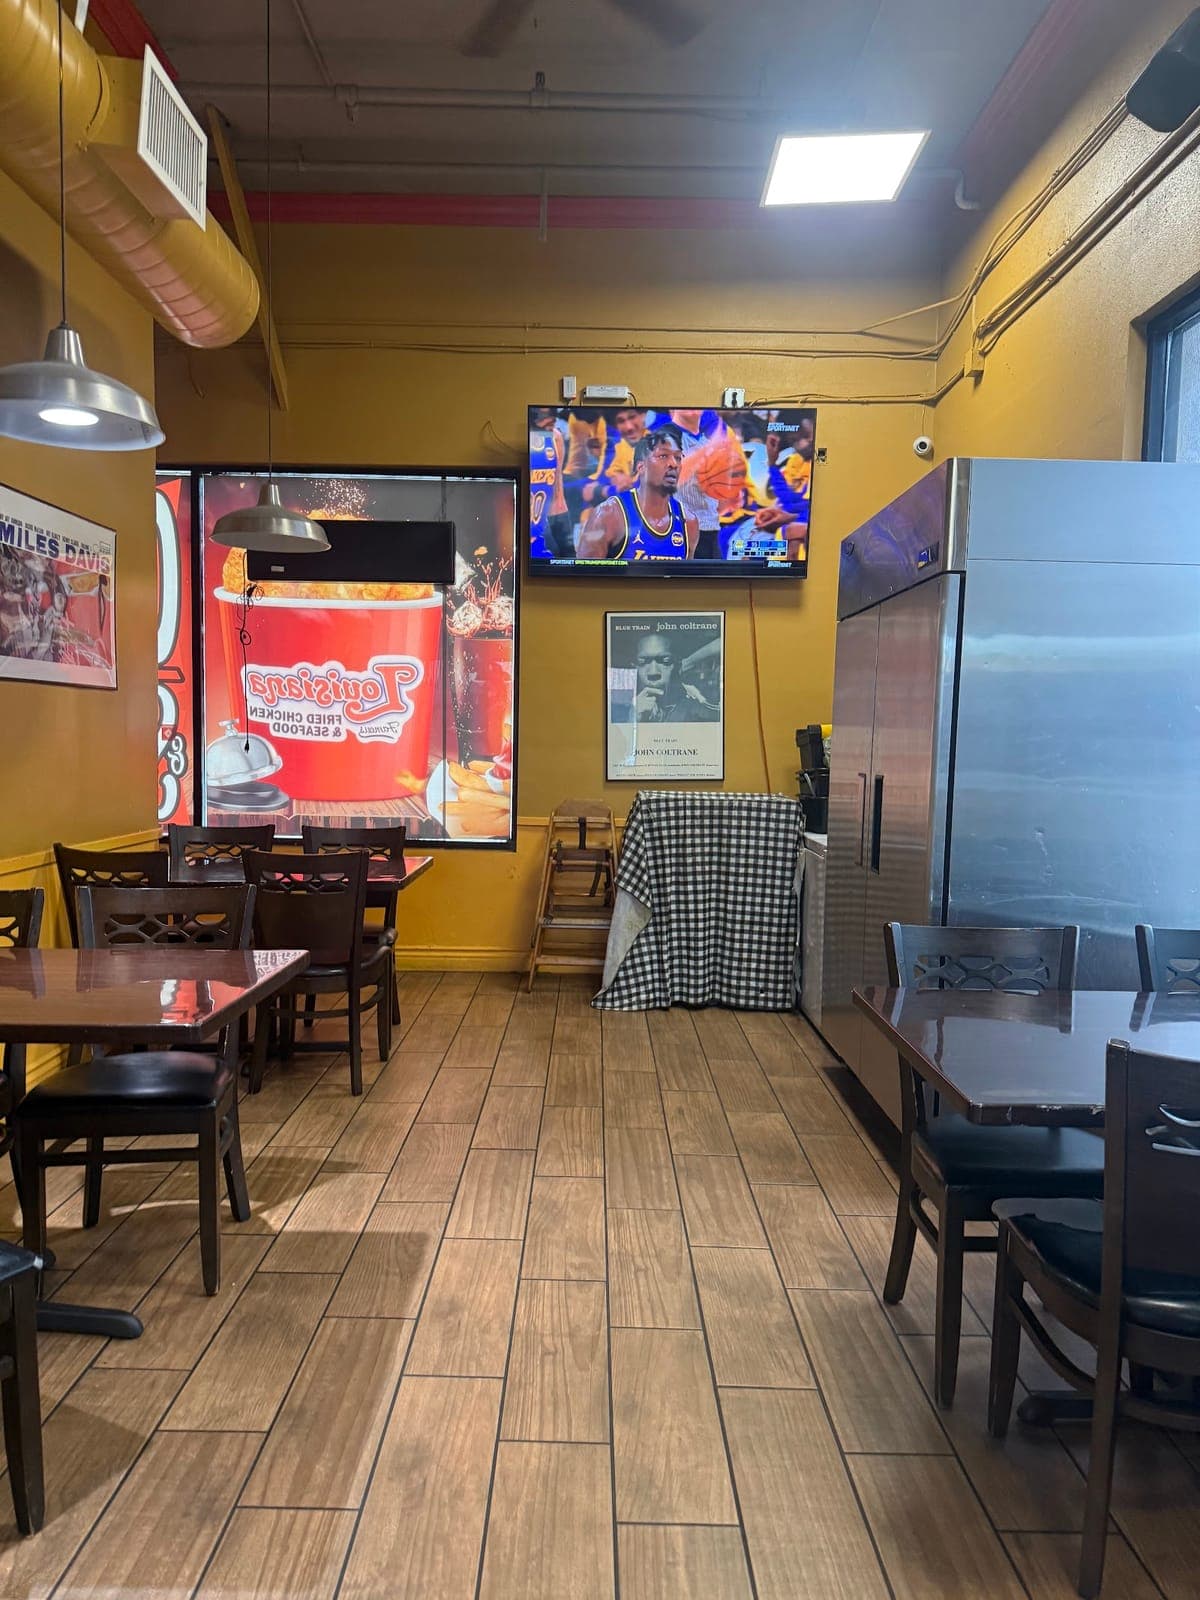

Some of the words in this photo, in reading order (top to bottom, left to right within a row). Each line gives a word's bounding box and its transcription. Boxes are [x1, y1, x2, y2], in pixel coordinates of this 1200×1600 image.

[0, 520, 60, 559] MILES
[65, 543, 110, 575] DAVIS
[656, 622, 677, 632] john
[679, 622, 718, 631] coltrane
[634, 748, 654, 757] JOHN
[656, 748, 698, 756] COLTRANE
